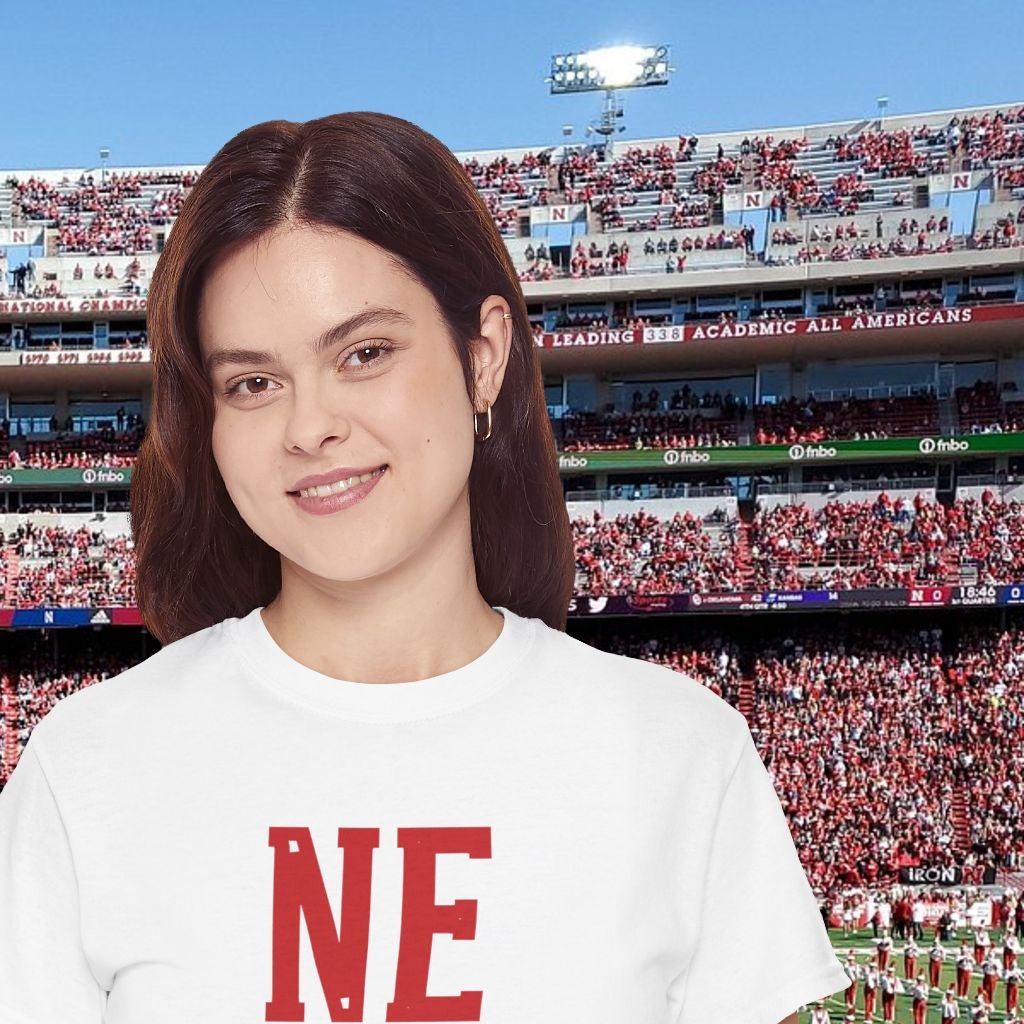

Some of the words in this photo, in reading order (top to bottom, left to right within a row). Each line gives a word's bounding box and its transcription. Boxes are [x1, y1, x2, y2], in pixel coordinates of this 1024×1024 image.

[552, 330, 635, 347] LEADING
[646, 328, 680, 340] 338
[692, 321, 796, 339] ACADEMIC
[806, 318, 842, 333] ALL
[852, 308, 972, 329] AMERICANS
[937, 438, 969, 451] fnbo
[680, 451, 711, 463] fnbo
[806, 445, 837, 458] fnbo
[559, 455, 588, 468] fnbo
[98, 471, 124, 482] fnbo
[960, 586, 996, 598] 18:46
[908, 866, 956, 882] IRON
[265, 826, 492, 1023] NE
